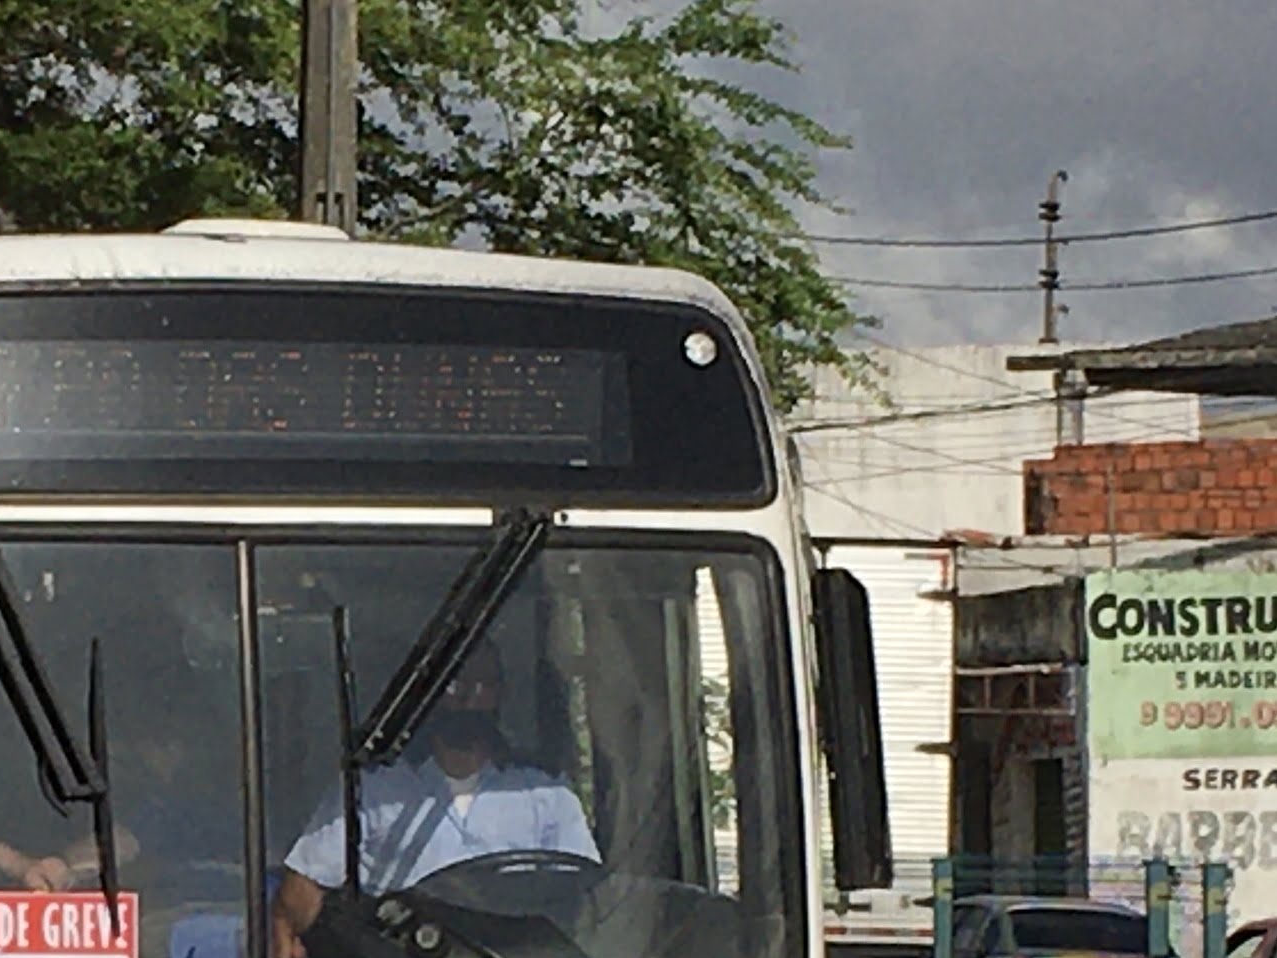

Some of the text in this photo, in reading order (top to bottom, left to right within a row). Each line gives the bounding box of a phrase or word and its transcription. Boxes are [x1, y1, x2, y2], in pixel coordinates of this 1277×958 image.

[1089, 593, 1277, 640] CONSTRU
[1122, 640, 1277, 663] ESQUADRIA MO
[1164, 701, 1277, 730] 9991.0
[1182, 768, 1277, 790] SERRA
[42, 902, 128, 949] GREVE
